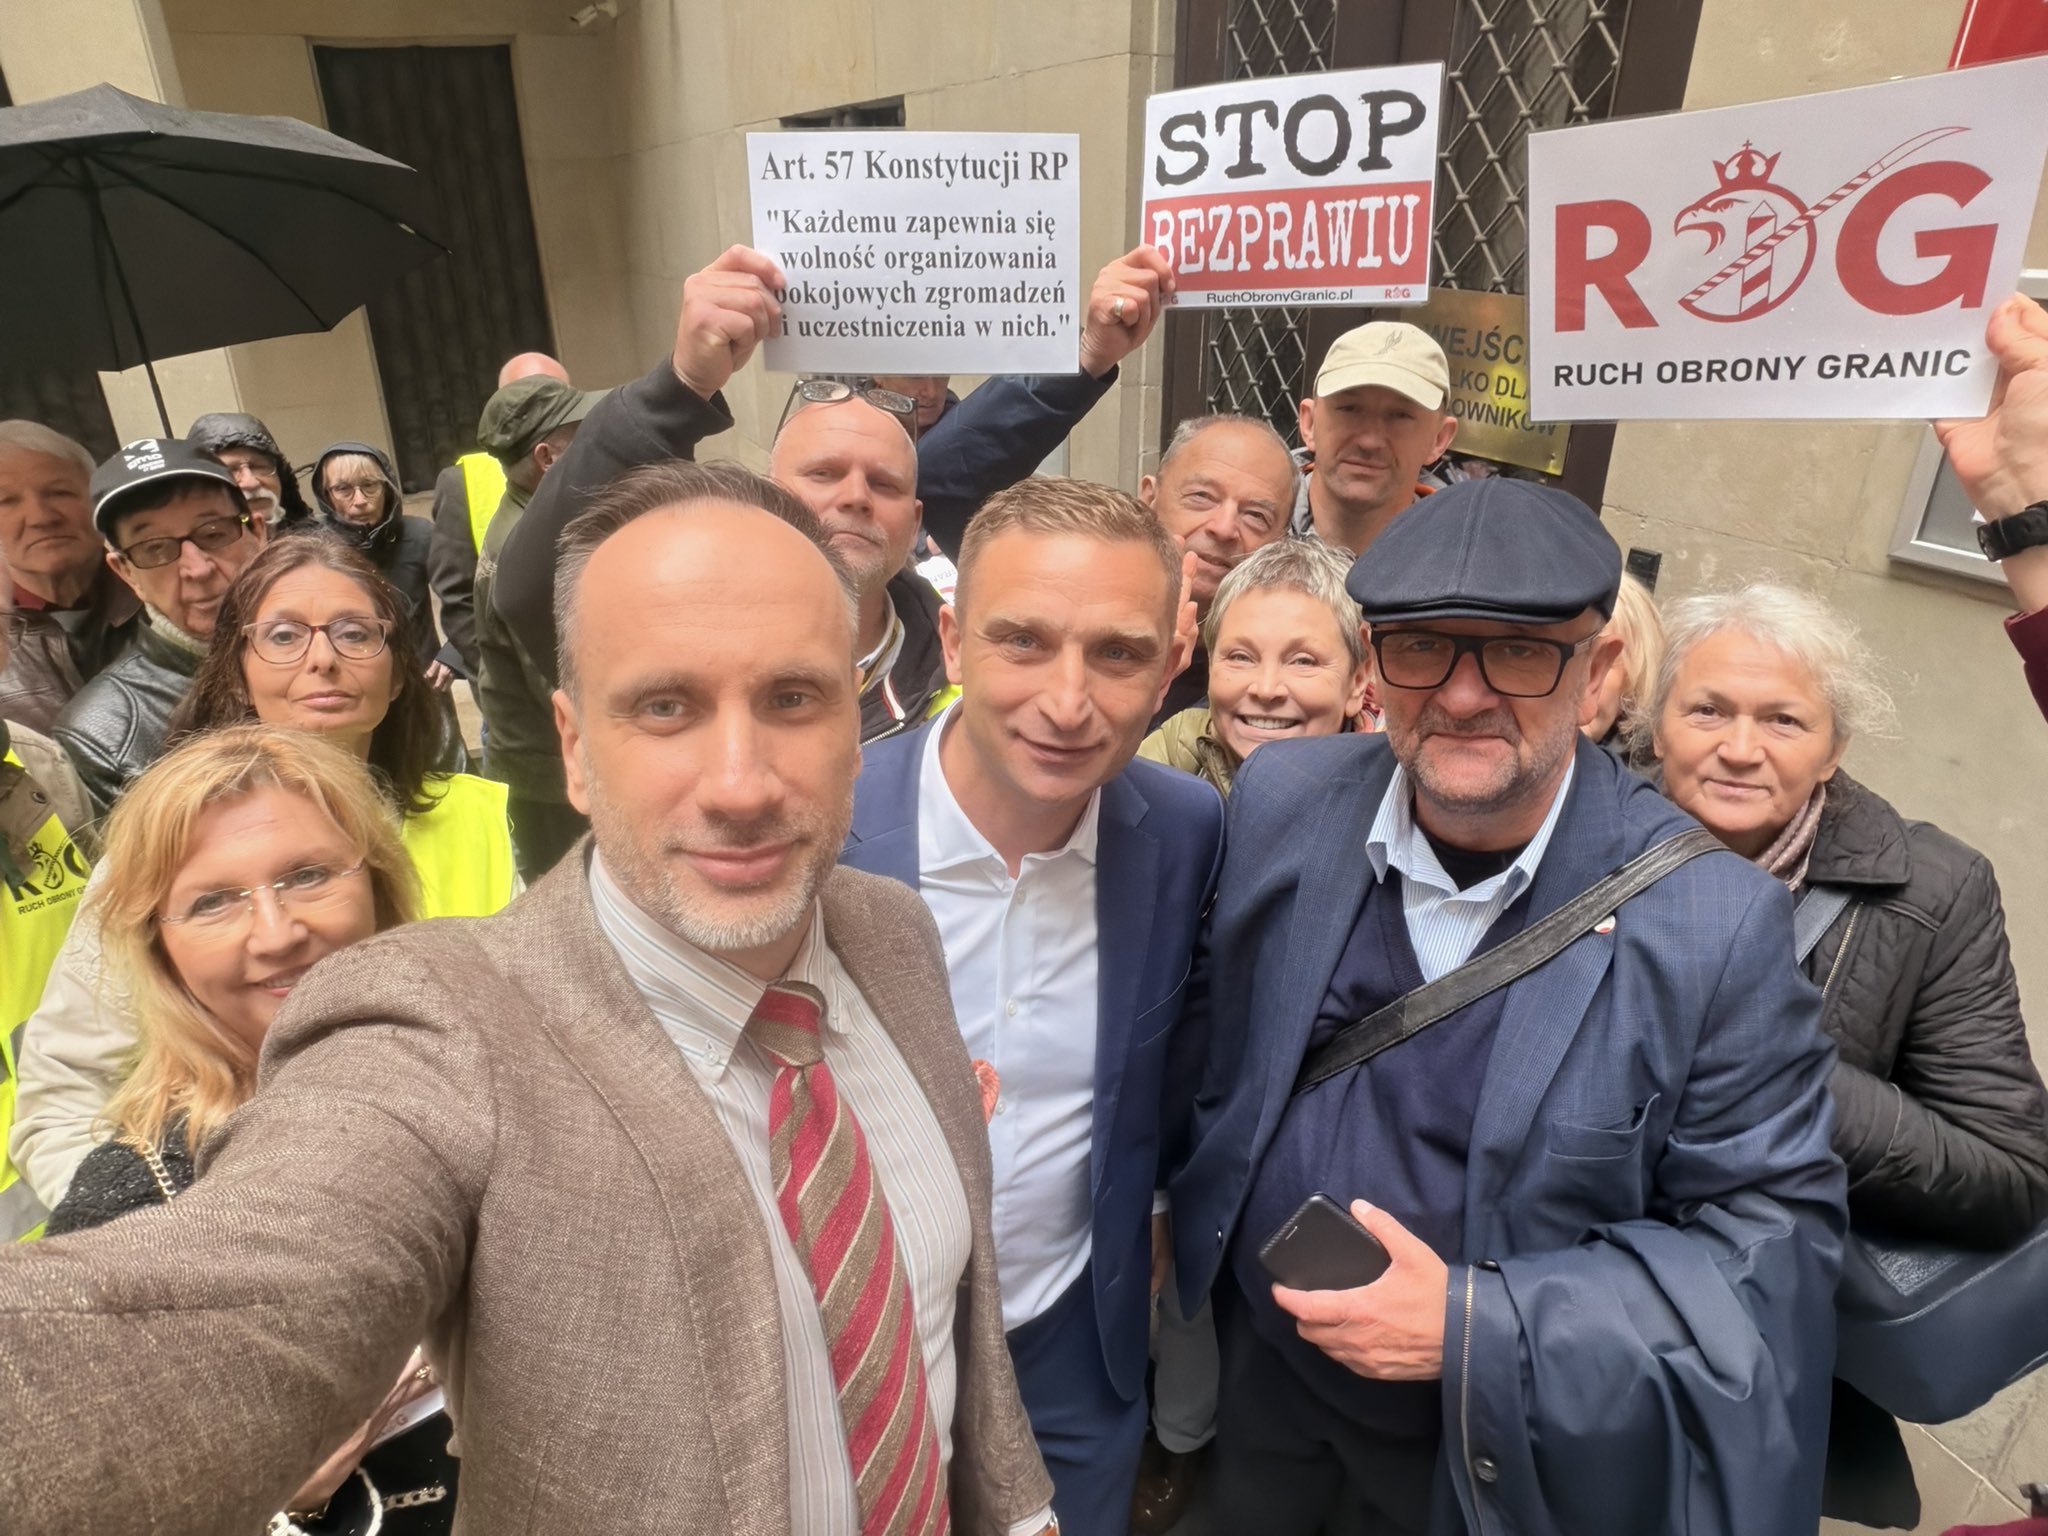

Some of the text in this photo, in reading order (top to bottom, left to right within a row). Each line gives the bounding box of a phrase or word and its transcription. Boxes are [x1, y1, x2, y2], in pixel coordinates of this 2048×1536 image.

[1156, 89, 1427, 186] STOP
[761, 150, 1068, 188] Art. 57 Konstytucji RP
[767, 209, 1056, 241] "Każdemu zapewnia się
[1152, 193, 1421, 275] BEZPRAWIU
[780, 244, 1057, 275] wolność organizowania
[925, 280, 1065, 310] zgromadzeń
[1207, 289, 1353, 304] RuchObronyGranic.pl
[782, 312, 1070, 338] i uczestniczenia w nich."
[1424, 324, 1528, 365] WEJŚC
[1554, 349, 1971, 387] RUCH OBRONY GRANIC
[1494, 375, 1527, 400] DL
[18, 899, 46, 915] RUCH
[46, 888, 76, 905] OBRONY
